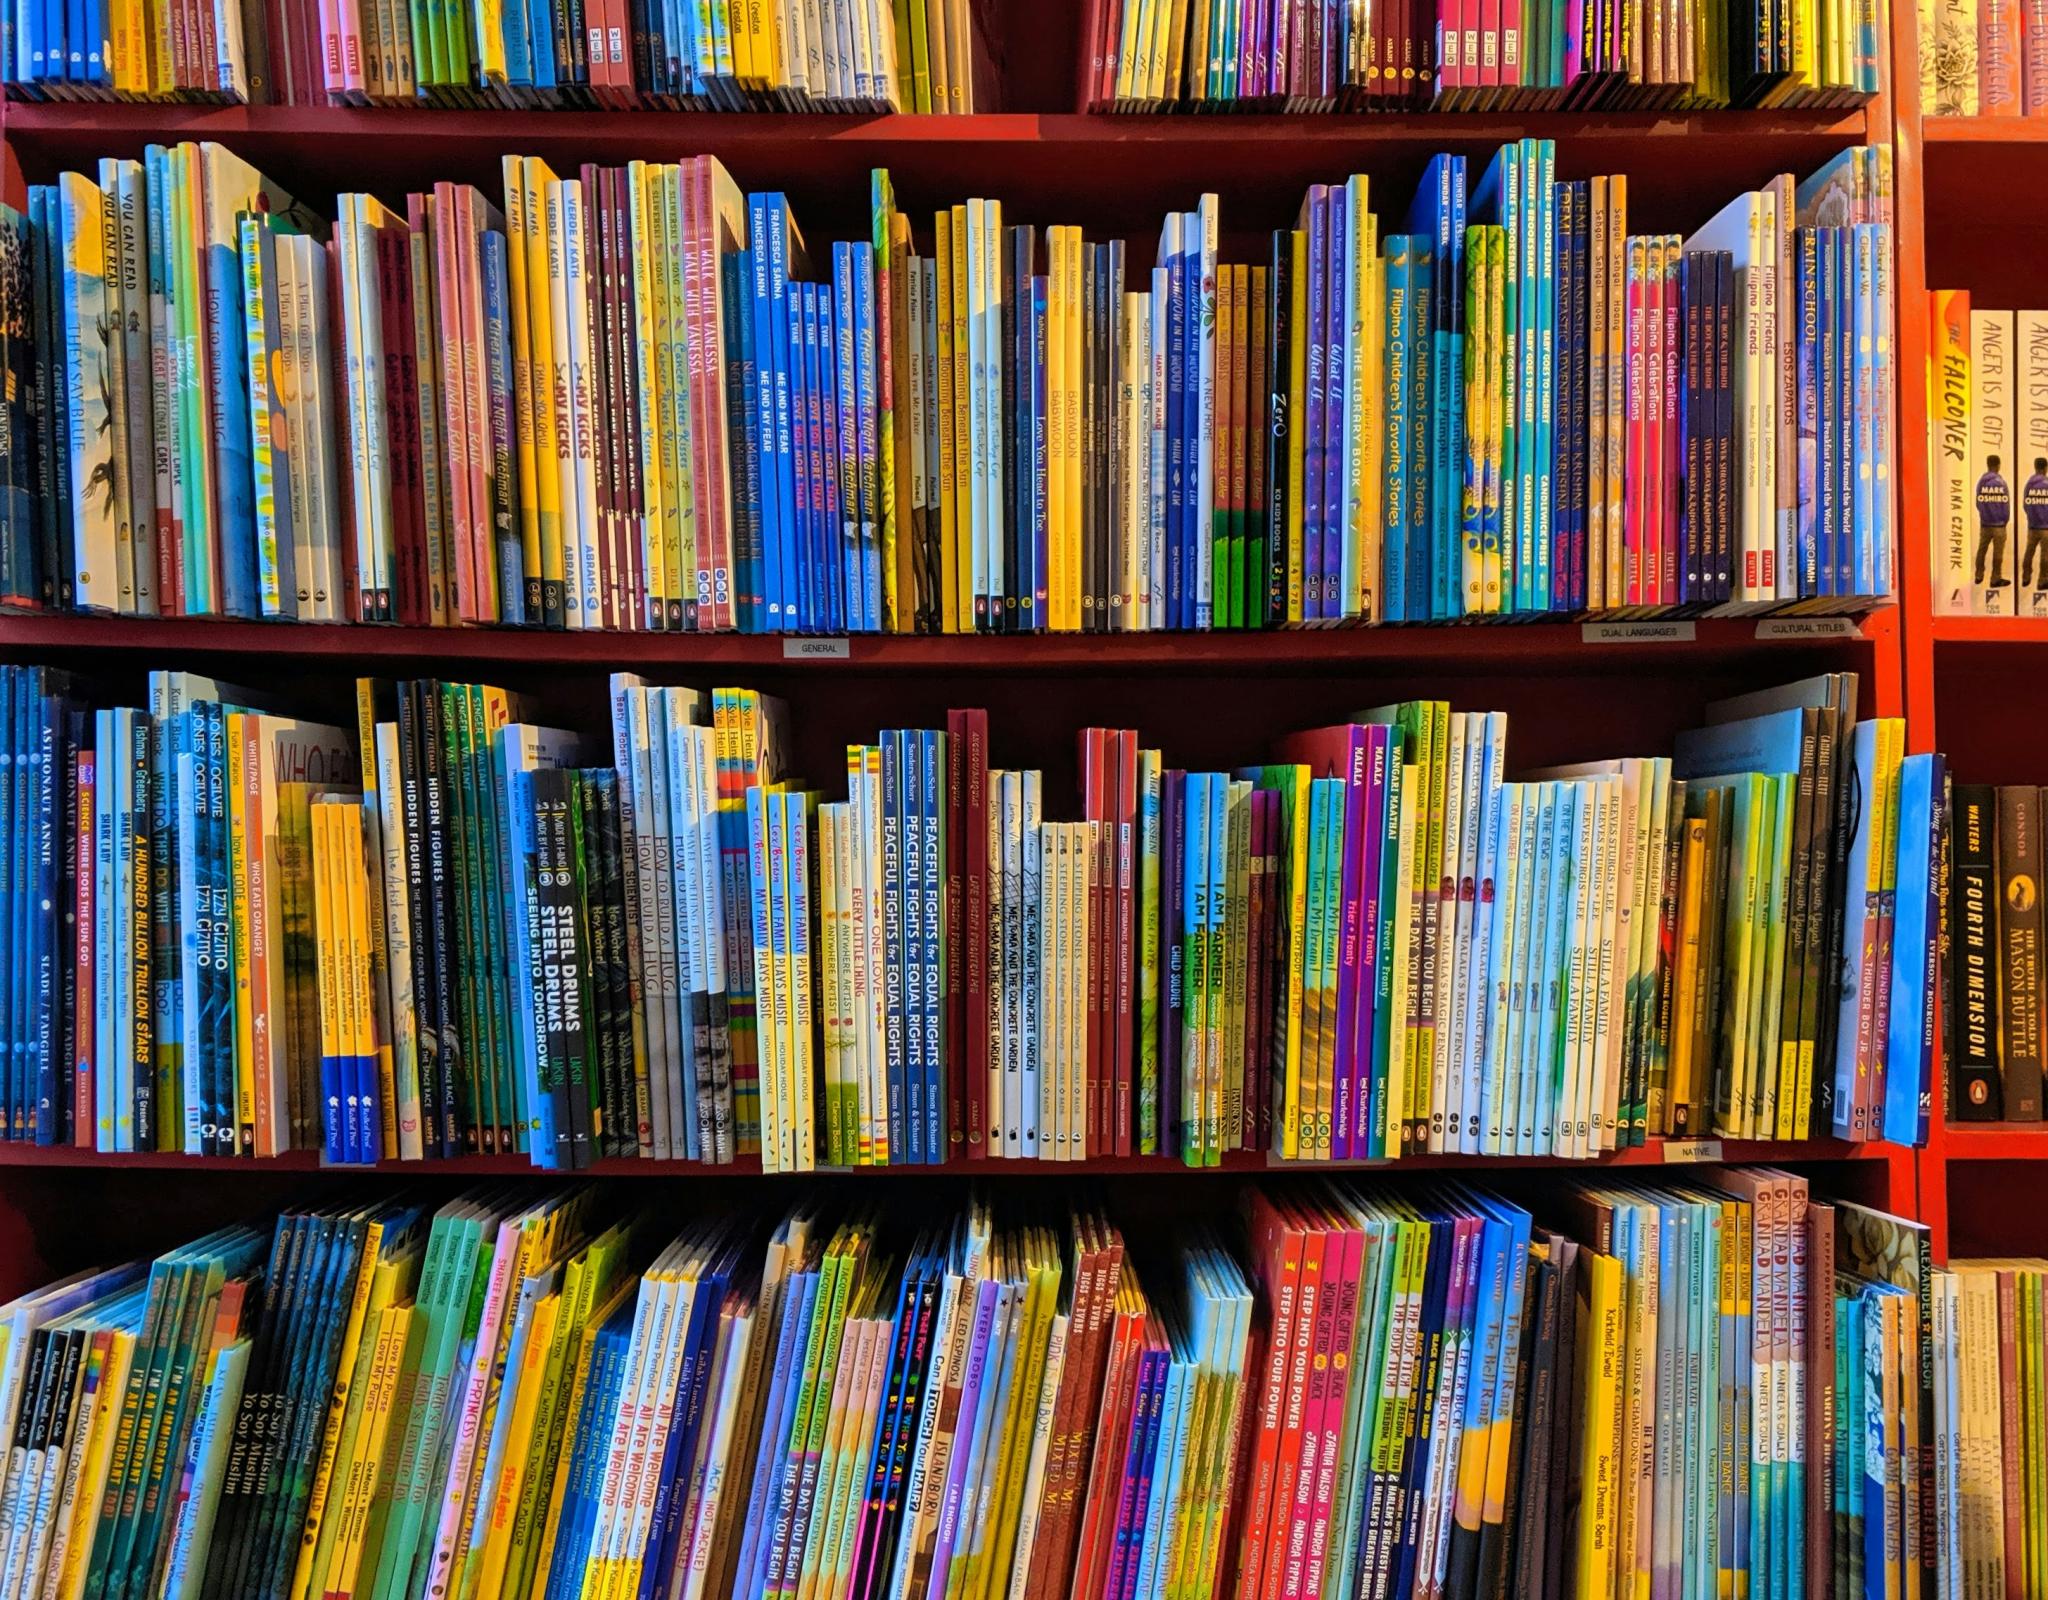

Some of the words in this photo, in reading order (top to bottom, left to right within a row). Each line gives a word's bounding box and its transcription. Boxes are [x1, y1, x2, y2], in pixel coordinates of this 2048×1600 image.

[348, 40, 357, 70] TUTTLE
[123, 194, 134, 223] YOU
[123, 226, 135, 253] CAN
[770, 209, 780, 264] FRANCESCA
[700, 249, 714, 282] WALK
[1804, 237, 1816, 276] RAIN
[125, 257, 136, 290] READ
[772, 267, 782, 299] SANNA
[702, 287, 716, 313] WITH
[1389, 288, 1404, 336] Filipino
[1804, 281, 1817, 345] SCHOOL
[1525, 329, 1533, 350] BABY
[1629, 308, 1643, 347] Filipino
[1948, 321, 1960, 344] THE
[67, 324, 83, 368] THEY
[703, 319, 718, 376] VANESSA:
[1352, 346, 1363, 372] THE
[1783, 342, 1794, 370] ESOS
[1981, 320, 2001, 375] ANGER
[776, 372, 786, 386] ME
[954, 352, 968, 399] Blooming
[1154, 354, 1163, 378] HAND
[1389, 340, 1405, 410] Children's
[1525, 354, 1533, 376] GOES
[69, 373, 84, 406] SAY
[776, 389, 787, 409] AND
[1154, 381, 1163, 403] OVER
[1524, 379, 1533, 389] TO
[1629, 353, 1643, 420] Celebrations
[1784, 374, 1794, 426] ZAPATOS
[1983, 381, 2001, 394] IS
[777, 412, 787, 427] MY
[957, 403, 969, 444] Beneath
[1155, 407, 1163, 430] HAND
[1351, 378, 1362, 444] LIBRARY
[1524, 391, 1532, 423] MARKET
[1942, 355, 1967, 461] FALCONER
[71, 407, 86, 452] BLUE
[1035, 416, 1046, 438] Love
[1067, 390, 1079, 459] BABYMOON
[1983, 416, 2002, 449] GIFT
[778, 430, 788, 454] FEAR
[957, 448, 969, 465] the
[1035, 441, 1046, 461] You
[1389, 415, 1403, 471] Favorite
[958, 468, 970, 487] Sun
[1035, 465, 1046, 495] Head
[1351, 448, 1361, 486] BOOK
[1036, 499, 1046, 508] to
[1388, 477, 1403, 527] Stories
[1522, 474, 1531, 535] CANDLEWICK
[1950, 479, 1962, 509] DANA
[1036, 512, 1046, 531] Toe
[1522, 538, 1530, 565] PRESS
[1950, 516, 1963, 569] CZAPNIK
[584, 545, 597, 593] ABRAMS
[1601, 628, 1623, 638] DUAL
[1626, 627, 1678, 637] LANGUAGES
[1772, 624, 1814, 634] CULTURAL
[1817, 623, 1846, 633] TITLES
[802, 644, 837, 652] GENERAL
[40, 726, 52, 816] ASTRONAUT
[248, 740, 258, 796] WHITE/PAGE
[927, 744, 935, 803] Sanders/Schorr
[1389, 746, 1400, 791] WANGARI
[406, 780, 418, 828] HIDDEN
[1387, 793, 1399, 840] MAATHAI
[41, 821, 51, 865] ANNIE
[1967, 805, 1979, 852] WALTERS
[409, 832, 421, 884] FIGURES
[924, 817, 938, 886] PEACEFUL
[134, 849, 147, 907] HUNDRED
[251, 862, 260, 881] WHO
[213, 889, 228, 918] Izzy
[252, 885, 261, 906] EATS
[793, 895, 805, 913] MY
[852, 888, 863, 922] EVERY
[1194, 892, 1204, 916] AM
[1966, 876, 1984, 946] FOURTH
[526, 888, 539, 937] SEEING
[924, 891, 938, 939] FIGHTS
[135, 911, 148, 959] BILLION
[214, 923, 230, 970] Gizmo
[252, 910, 262, 957] ORANGE?
[558, 905, 575, 960] STEEL
[794, 917, 806, 953] FAMILY
[853, 926, 864, 961] LITTLE
[530, 943, 542, 976] INTO
[925, 944, 939, 960] for
[1170, 946, 1182, 971] CHILD
[1192, 922, 1205, 988] FARMER
[1601, 939, 1613, 969] STILL
[2009, 928, 2025, 993] MASON
[796, 958, 808, 990] PLAYS
[854, 965, 865, 997] THING
[924, 964, 939, 1011] EQUAL
[1861, 961, 1874, 1009] THUNDER
[135, 963, 148, 1019] TRILLION
[562, 965, 580, 1031] DRUMS
[1169, 975, 1181, 1008] SOLDIER
[1968, 956, 1985, 1057] DIMENSION
[533, 984, 548, 1068] TOMORROW
[797, 994, 809, 1026] MUSIC
[1597, 987, 1610, 1037] FAMILY
[1860, 1013, 1870, 1032] BOY
[136, 1023, 149, 1063] STARS
[925, 1015, 939, 1066] RIGHTS
[2012, 997, 2026, 1058] BUTTLE
[799, 1041, 808, 1073] HOLIDAY
[1858, 1035, 1868, 1056] JR.
[801, 1076, 809, 1102] HOUSE
[929, 1084, 938, 1107] Simon
[1192, 1092, 1200, 1136] MILLBROOK
[929, 1121, 938, 1154] Schuster
[1682, 1147, 1710, 1156] NATIVE
[1757, 1191, 1772, 1267] GRANDAD
[1920, 1240, 1931, 1319] ALEXANDER
[1279, 1285, 1294, 1314] STEP
[1756, 1272, 1772, 1350] MANDELA
[1275, 1318, 1289, 1347] INTO
[1486, 1323, 1499, 1348] The
[932, 1355, 945, 1376] Can
[1269, 1350, 1286, 1382] YOUR
[1482, 1354, 1500, 1383] Bell
[1922, 1336, 1932, 1389] NELSON
[244, 1393, 257, 1409] Yo
[637, 1404, 654, 1421] All
[921, 1392, 939, 1438] TOUCH
[1264, 1386, 1281, 1429] POWER
[1477, 1388, 1495, 1425] Rang
[236, 1413, 255, 1438] Soy
[326, 1416, 340, 1435] HEY
[632, 1423, 649, 1447] Are
[225, 1441, 248, 1495] Muslim
[319, 1438, 337, 1473] BLACK
[916, 1441, 931, 1469] Your
[1597, 1455, 1609, 1482] Sweet
[620, 1451, 644, 1509] Welcome
[784, 1463, 799, 1484] THE
[924, 1440, 949, 1518] ISLANDBORN
[311, 1477, 330, 1512] CHILD
[779, 1488, 794, 1514] DAY
[909, 1471, 925, 1511] HAIR?
[774, 1517, 788, 1542] YOU
[1593, 1523, 1606, 1550] Sarah
